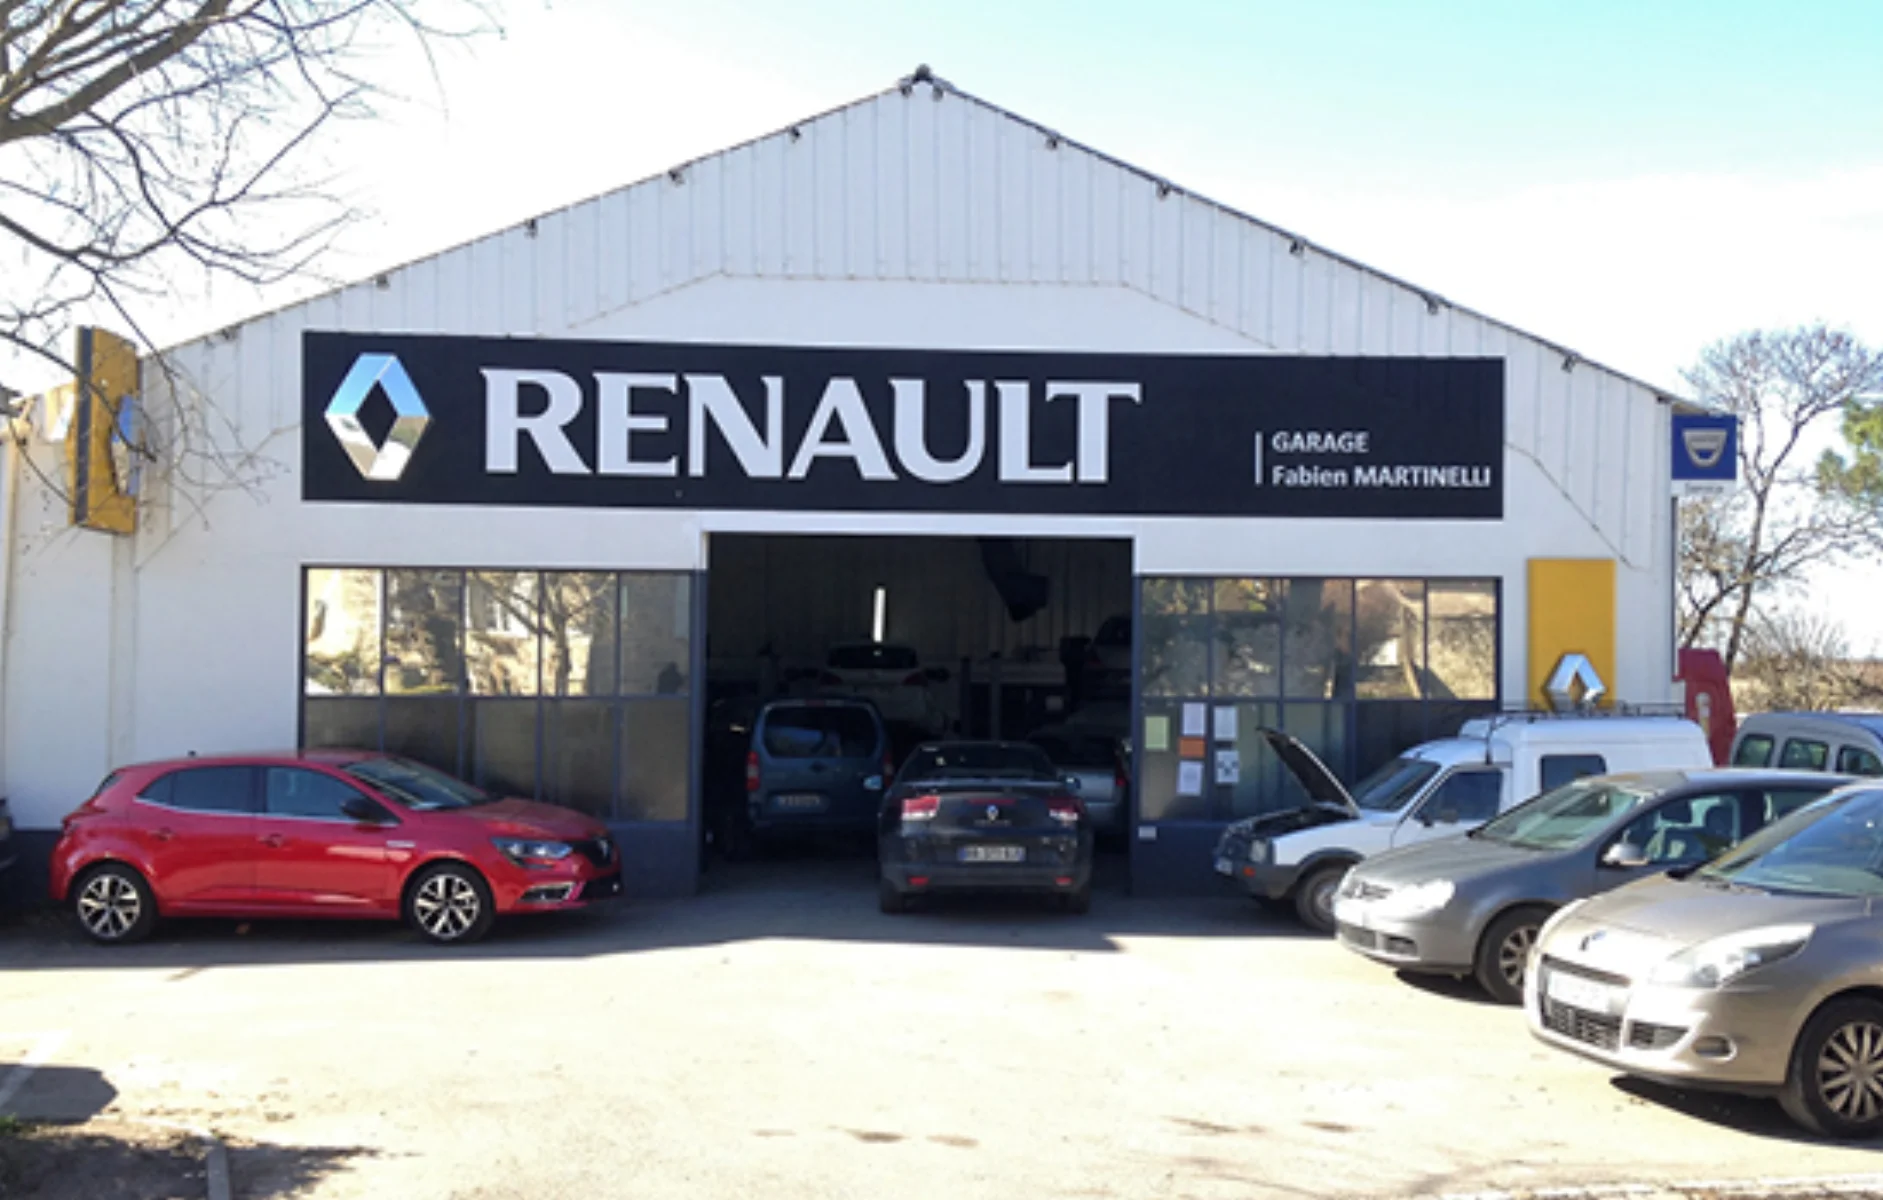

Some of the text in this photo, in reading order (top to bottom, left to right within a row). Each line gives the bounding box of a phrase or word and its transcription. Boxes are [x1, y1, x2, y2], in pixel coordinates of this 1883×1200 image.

[480, 367, 1141, 484] RENAULT
[1271, 430, 1369, 453] GARAGE
[1271, 464, 1491, 488] Fabien MARTINELLI
